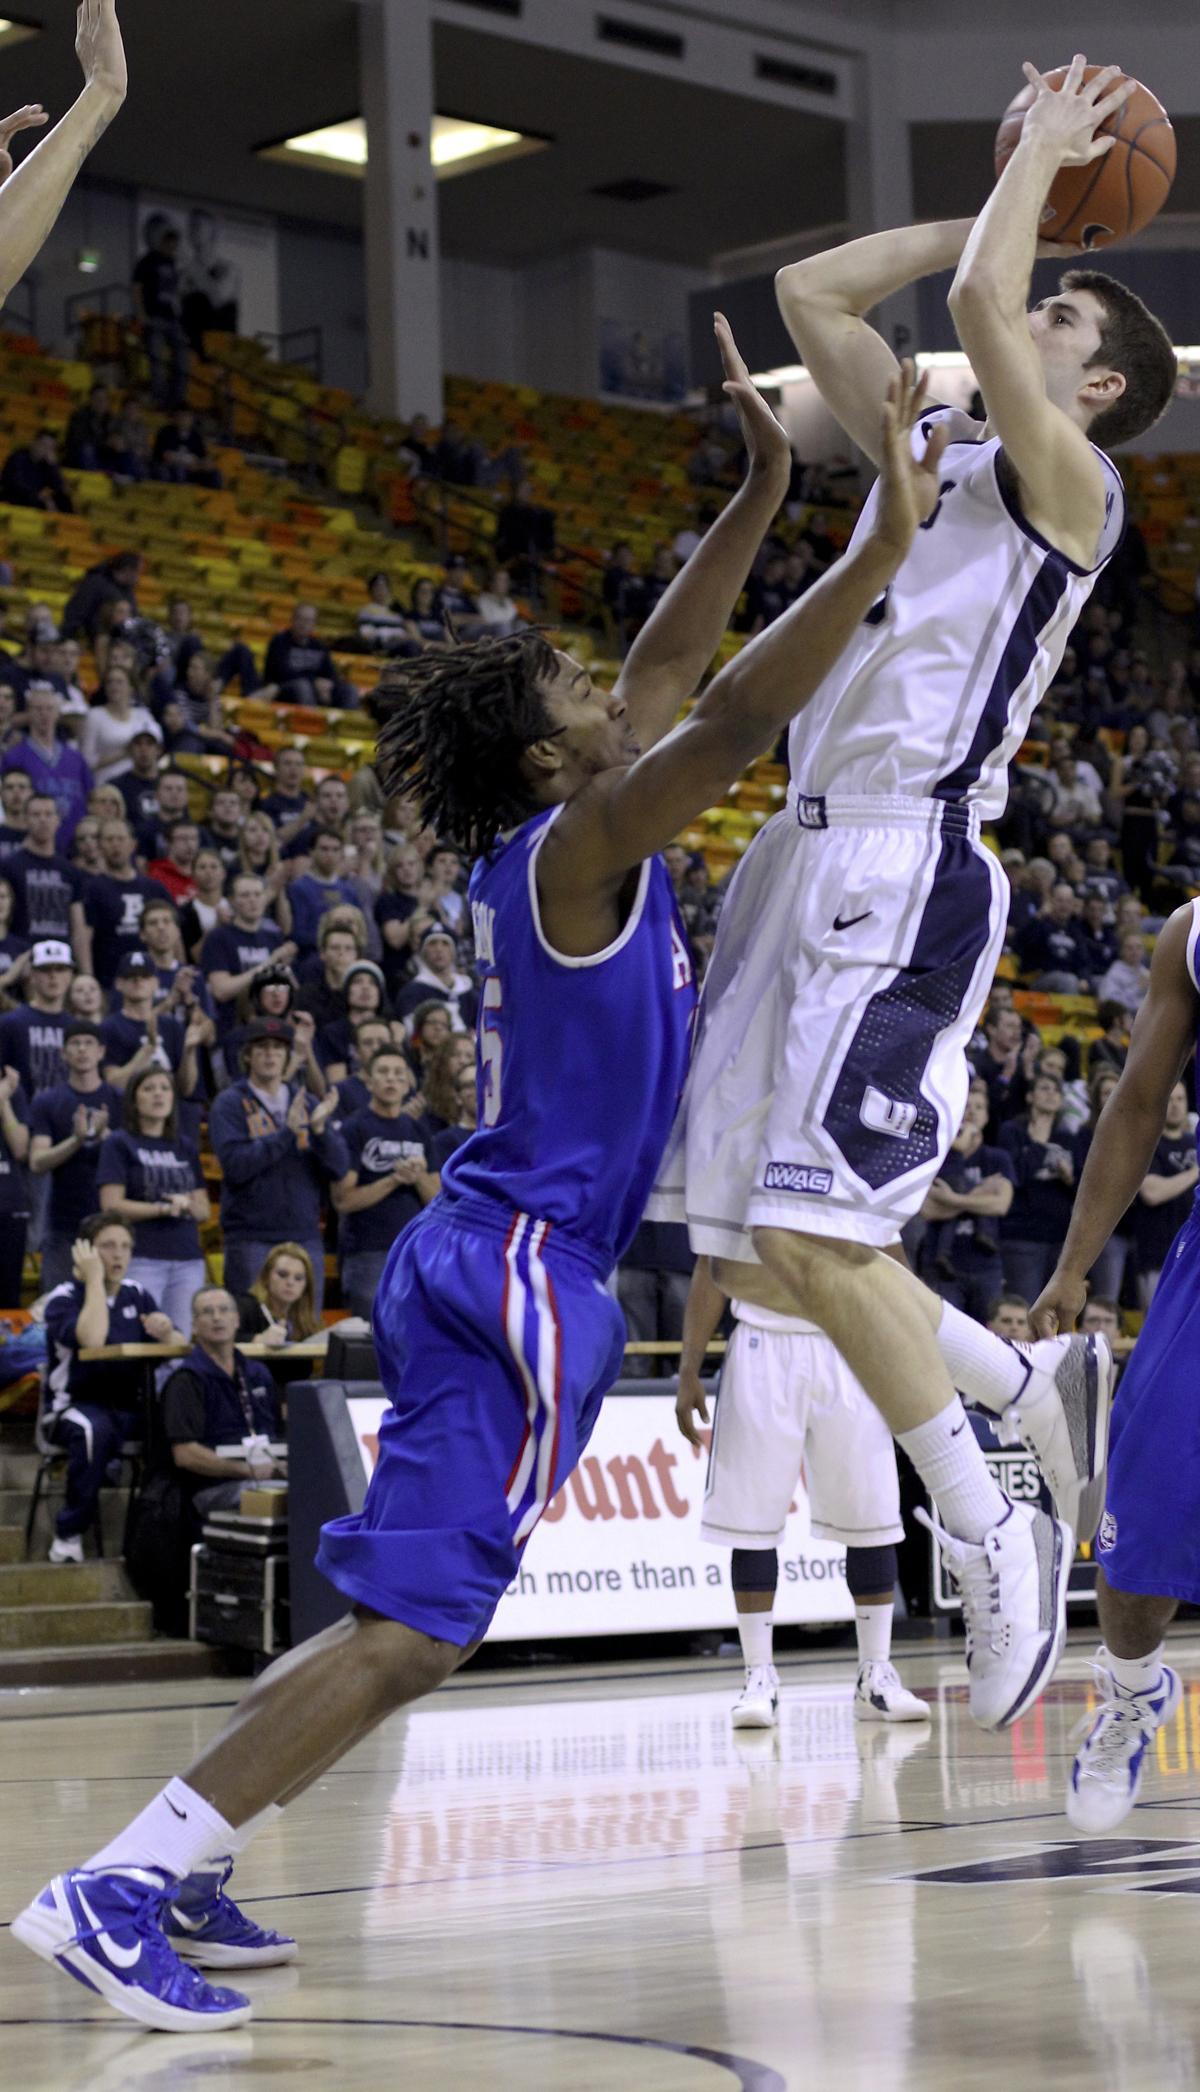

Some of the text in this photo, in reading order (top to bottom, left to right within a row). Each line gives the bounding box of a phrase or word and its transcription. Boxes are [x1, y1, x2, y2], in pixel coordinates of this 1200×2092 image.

[547, 1567, 622, 1594] more
[631, 1560, 695, 1590] than
[706, 1563, 721, 1586] a
